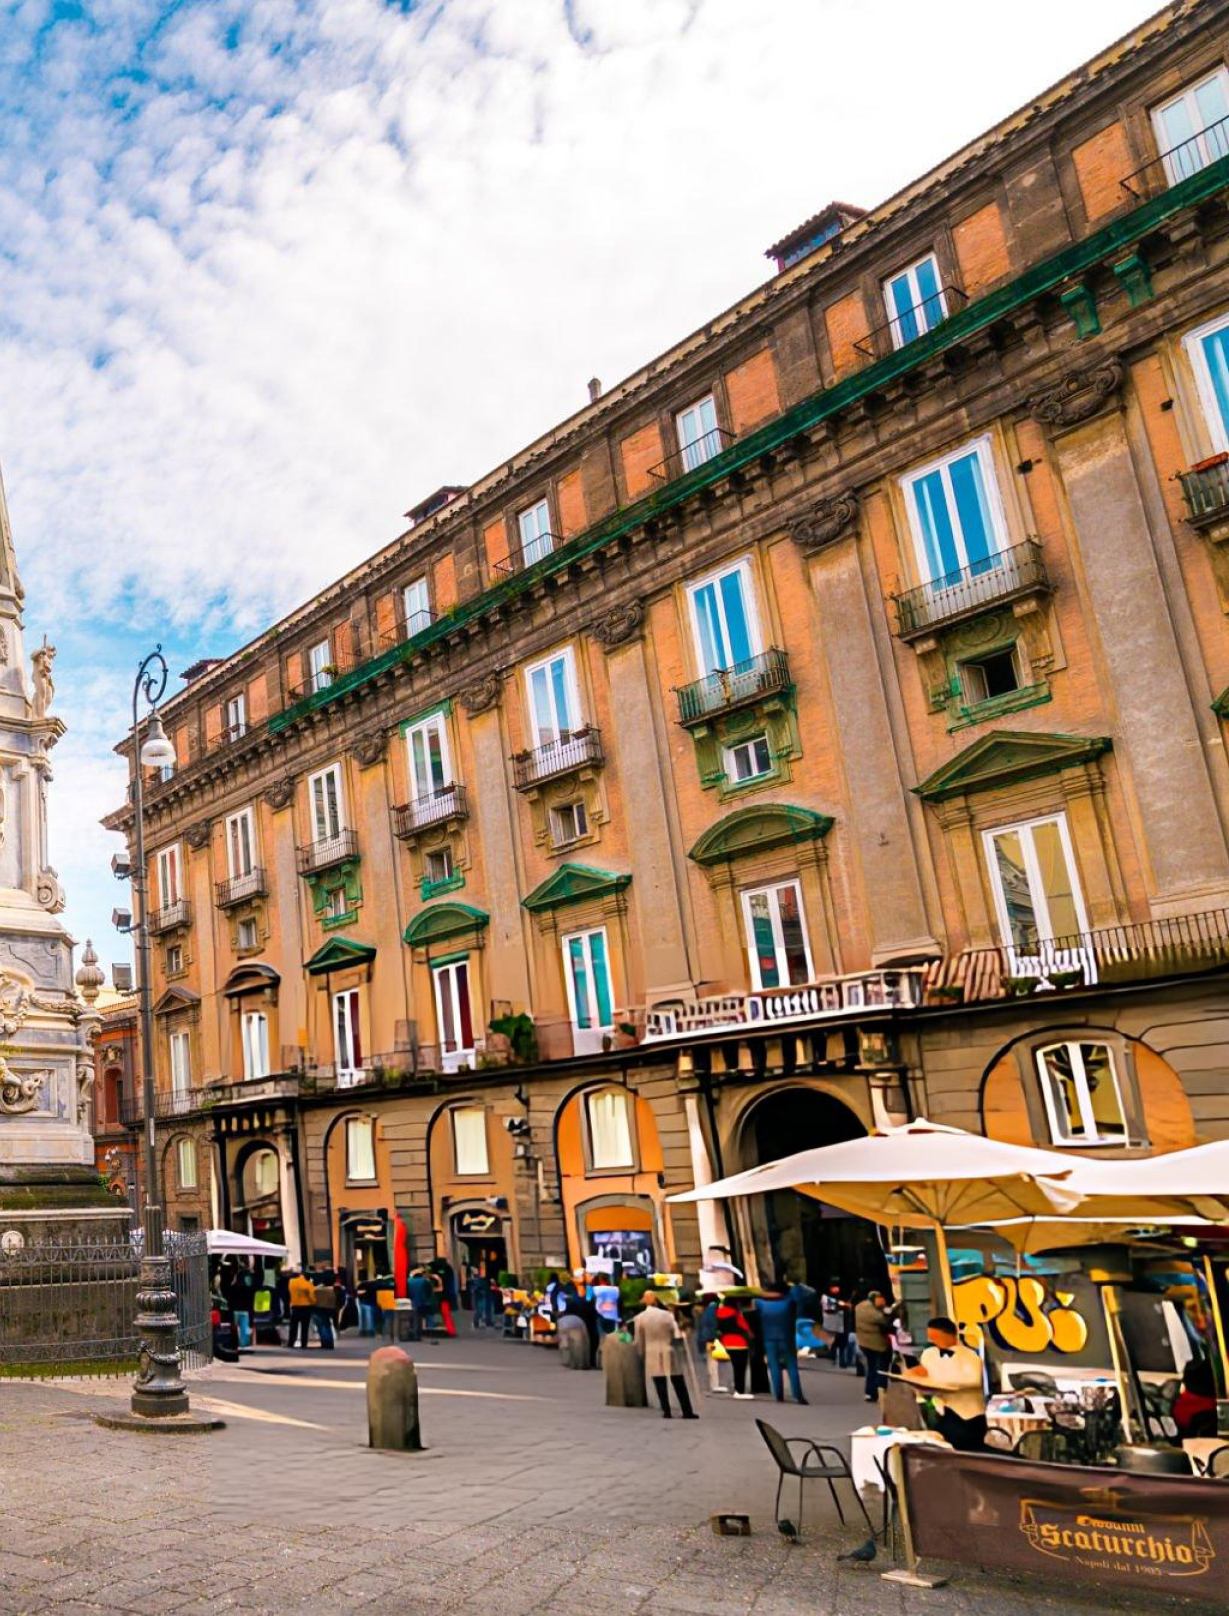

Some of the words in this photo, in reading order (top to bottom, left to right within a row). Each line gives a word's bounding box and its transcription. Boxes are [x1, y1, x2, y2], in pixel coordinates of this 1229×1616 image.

[1040, 1522, 1194, 1564] Scaturchio
[1076, 1555, 1111, 1570] Napoli
[1113, 1561, 1131, 1573] dal
